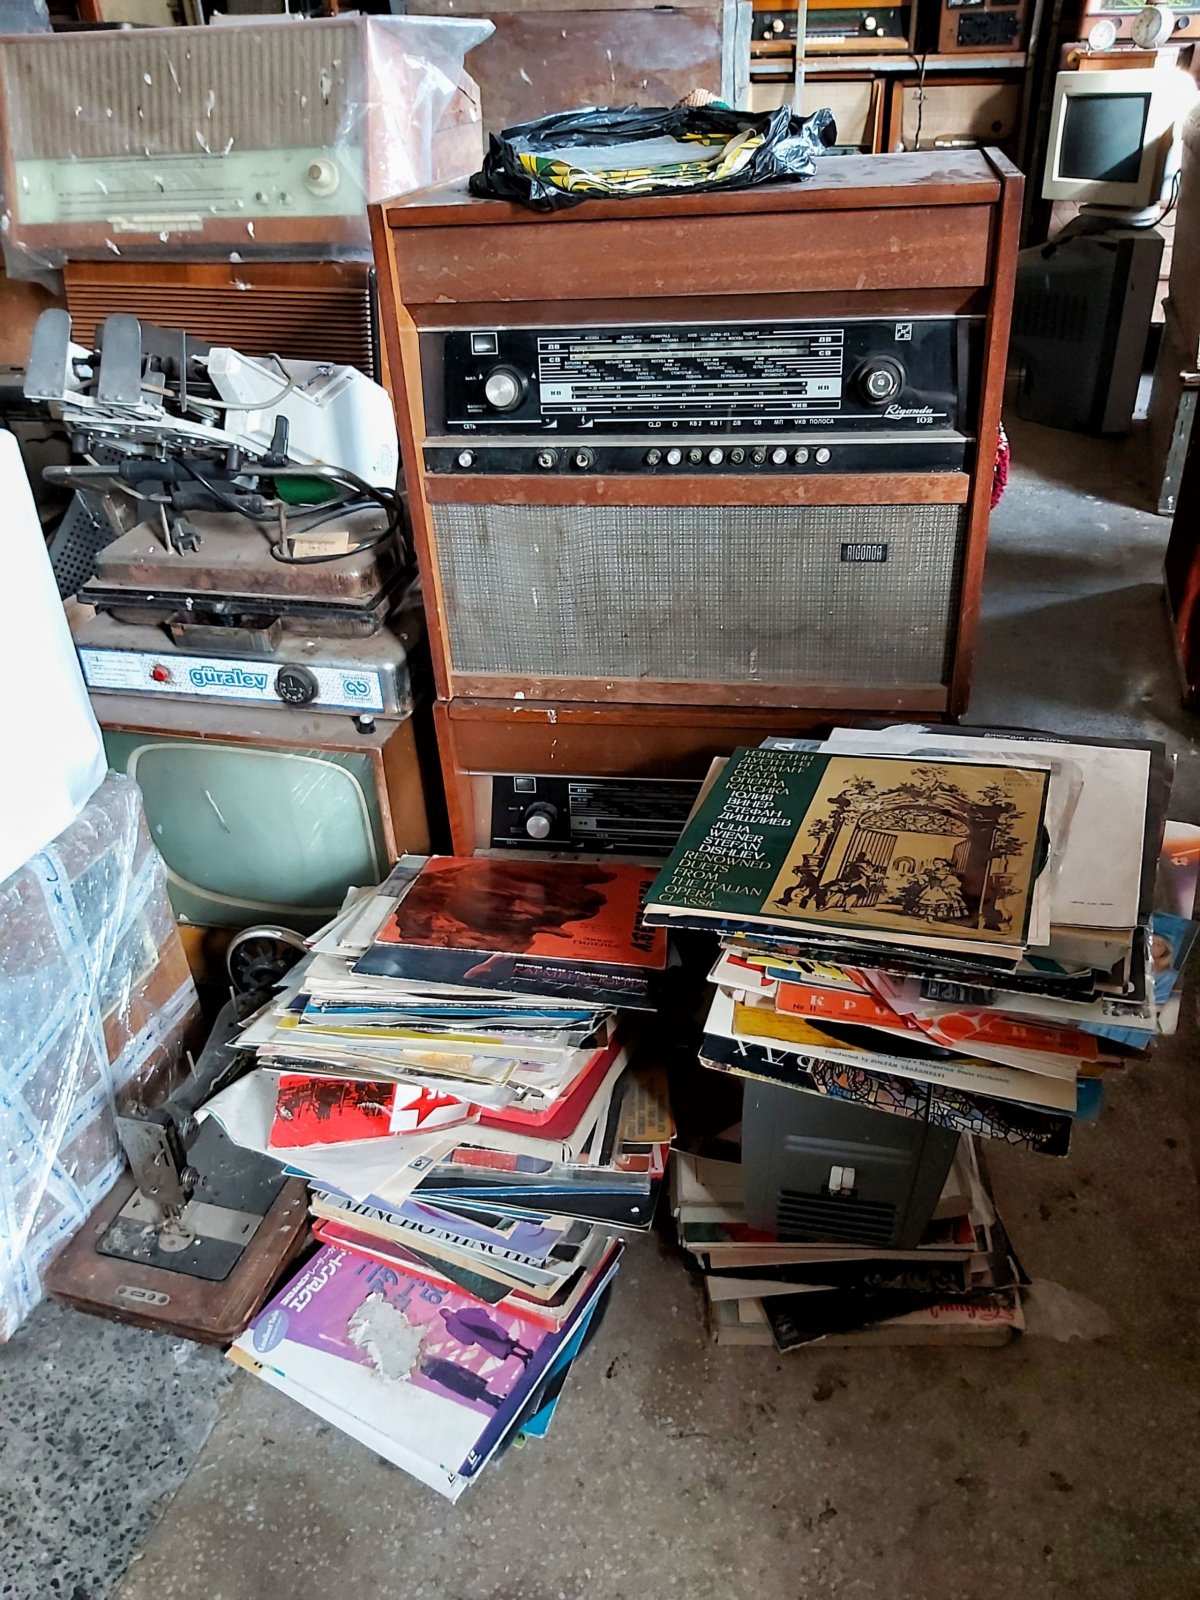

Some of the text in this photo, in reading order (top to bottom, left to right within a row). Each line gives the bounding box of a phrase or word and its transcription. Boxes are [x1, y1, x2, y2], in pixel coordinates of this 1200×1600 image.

[189, 666, 268, 690] güralev
[740, 756, 785, 766] ДУЕТИ
[730, 776, 785, 787] ОПЕРНА
[734, 770, 778, 779] СКАТА
[725, 783, 790, 795] КЛАСИКА
[731, 790, 774, 801] ЮЛИЯ
[727, 797, 774, 808] ВИНЕР
[723, 805, 782, 817] СТЕФАН
[717, 812, 792, 826] ДИШЛИЕВ
[712, 821, 750, 833] JULIA
[710, 828, 764, 844] WIENER
[703, 836, 761, 851] STEFAN
[699, 844, 765, 860] DISHLIEV
[679, 858, 730, 873] DUETS
[684, 850, 771, 870] RENOWNED
[673, 867, 719, 881] FROM
[665, 885, 715, 900] OPERA
[671, 876, 762, 896] THE ITALIAN
[658, 893, 721, 908] CLASSIC
